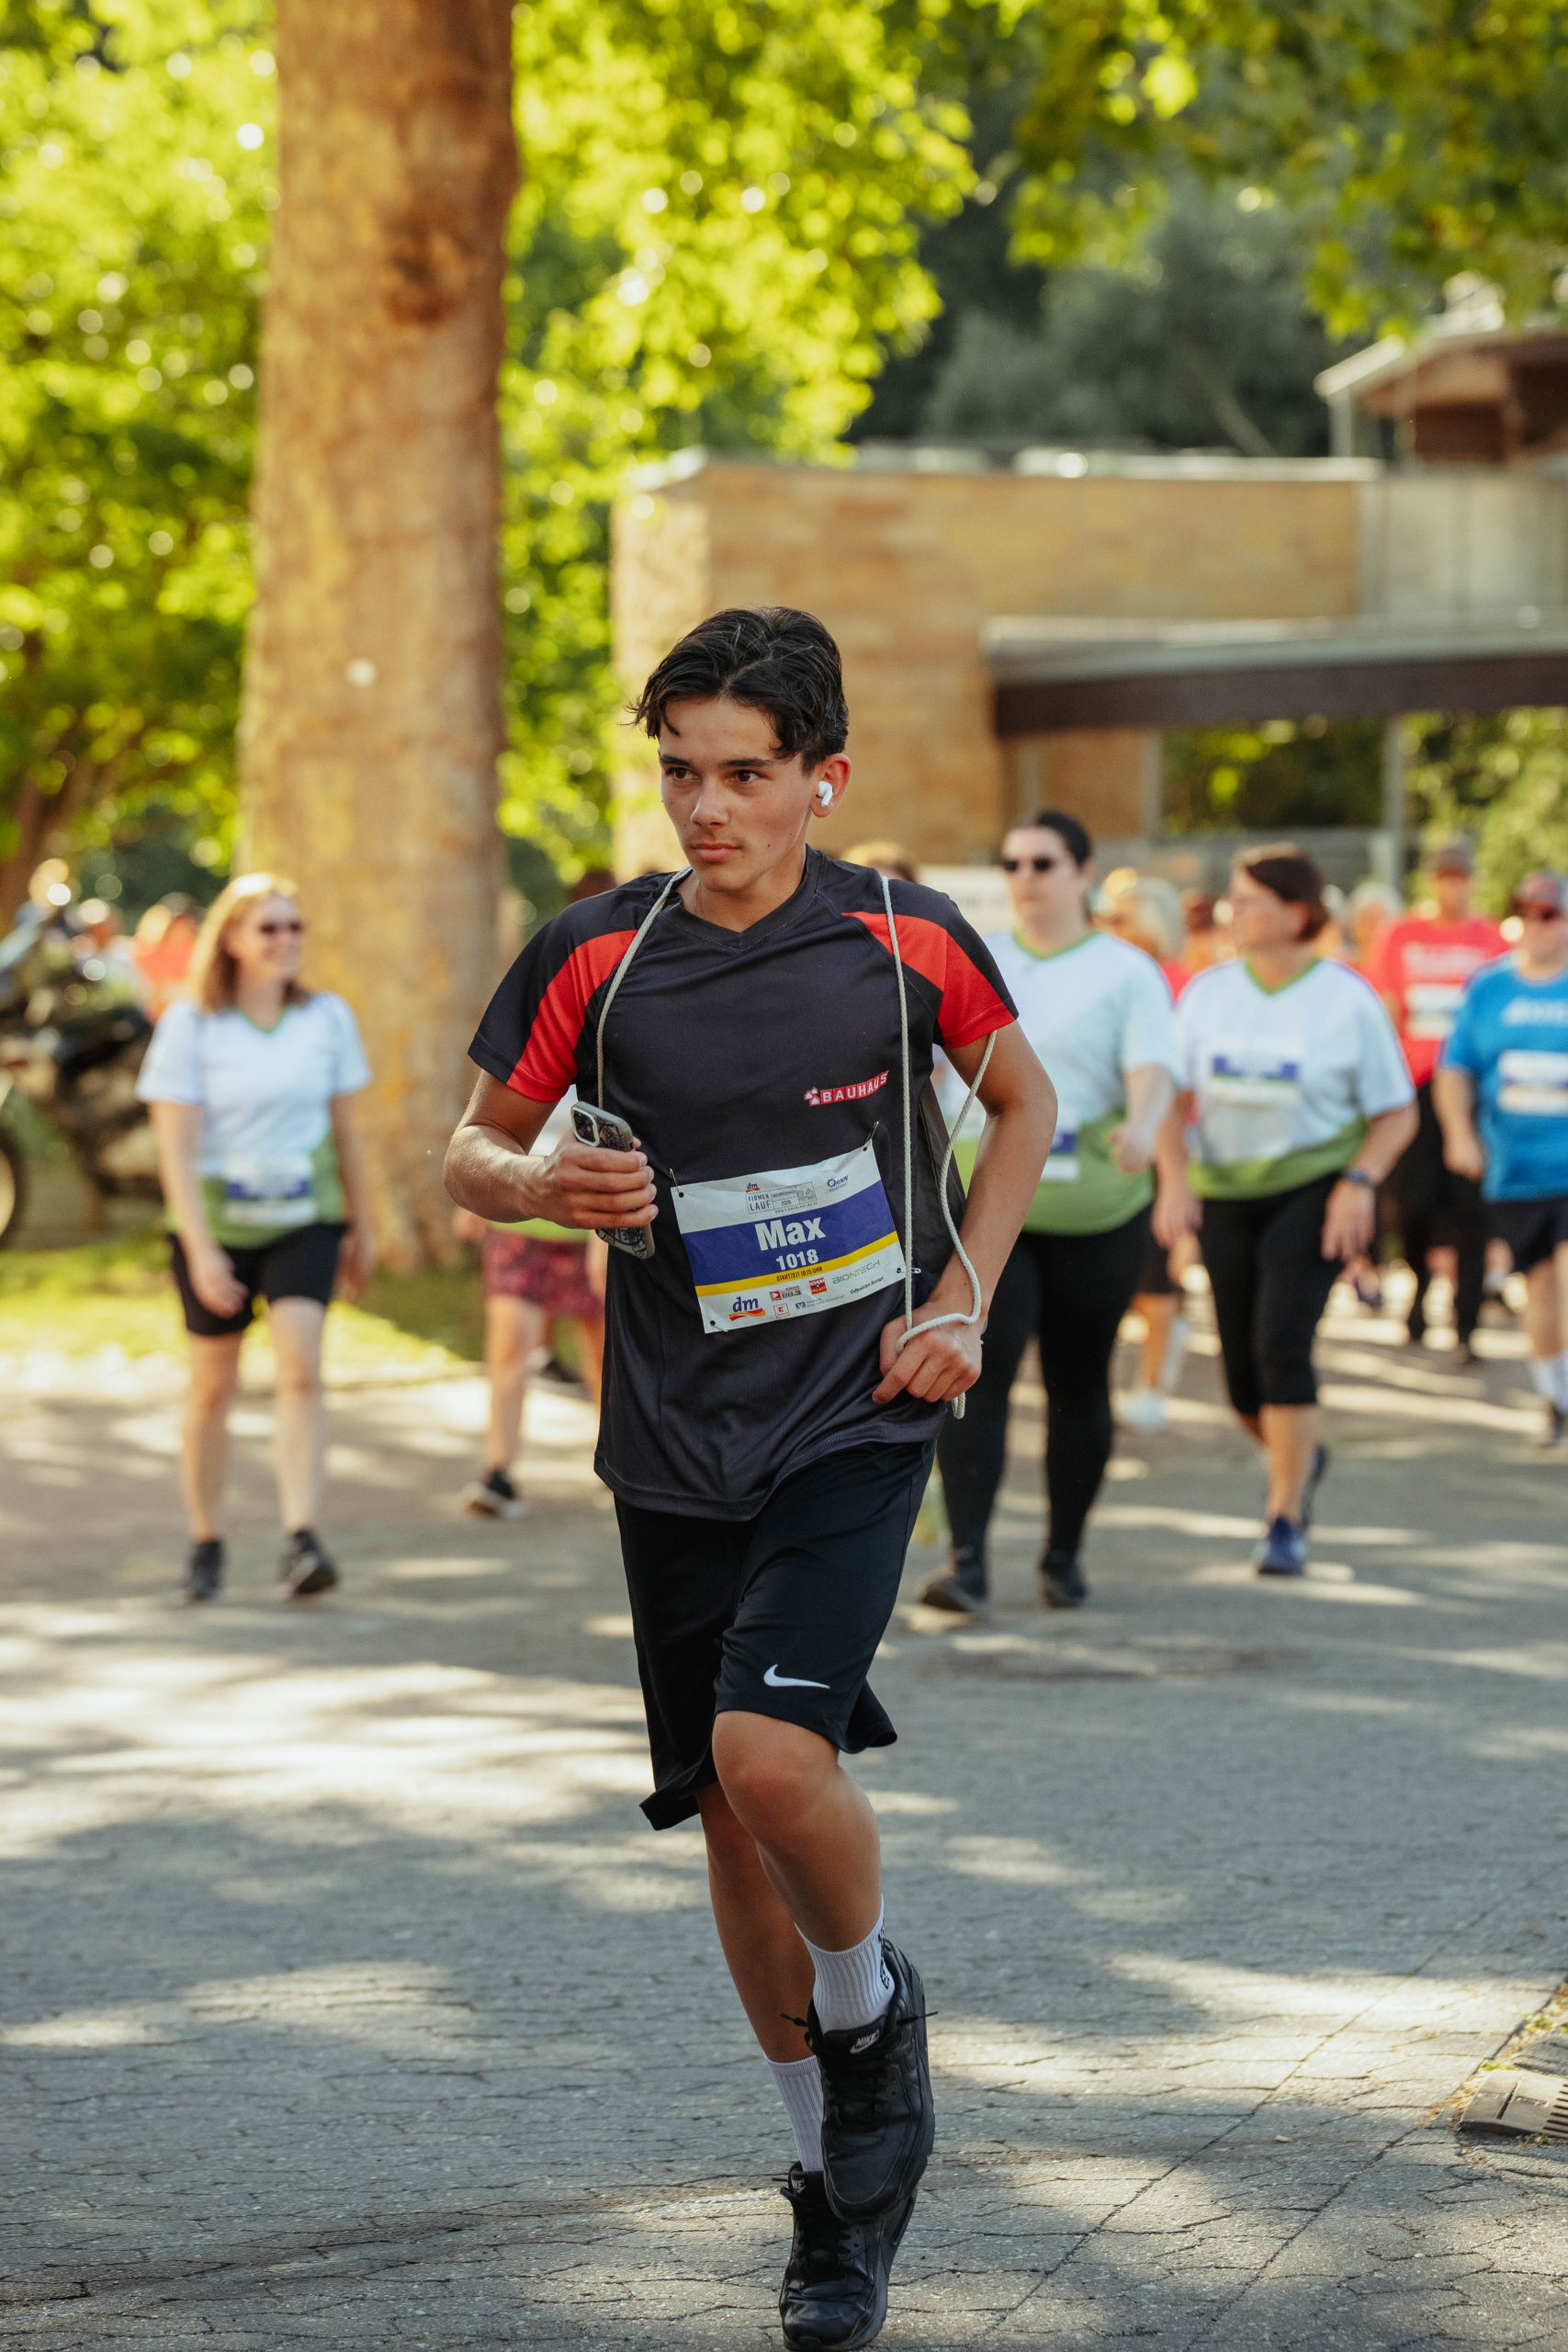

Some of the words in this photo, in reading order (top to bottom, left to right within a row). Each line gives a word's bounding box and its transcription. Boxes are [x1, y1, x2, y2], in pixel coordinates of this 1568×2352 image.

[822, 1071, 888, 1102] BAUHAUS
[748, 1193, 771, 1203] FIRMEN
[749, 1199, 772, 1212] LAUF
[754, 1216, 827, 1251] Max
[775, 1249, 819, 1271] 1018
[775, 1272, 801, 1283] STARTZEIT
[812, 1265, 823, 1275] UHR
[830, 1259, 882, 1285] BIONTECH
[732, 1296, 760, 1313] dm
[855, 2031, 876, 2048] NIKE
